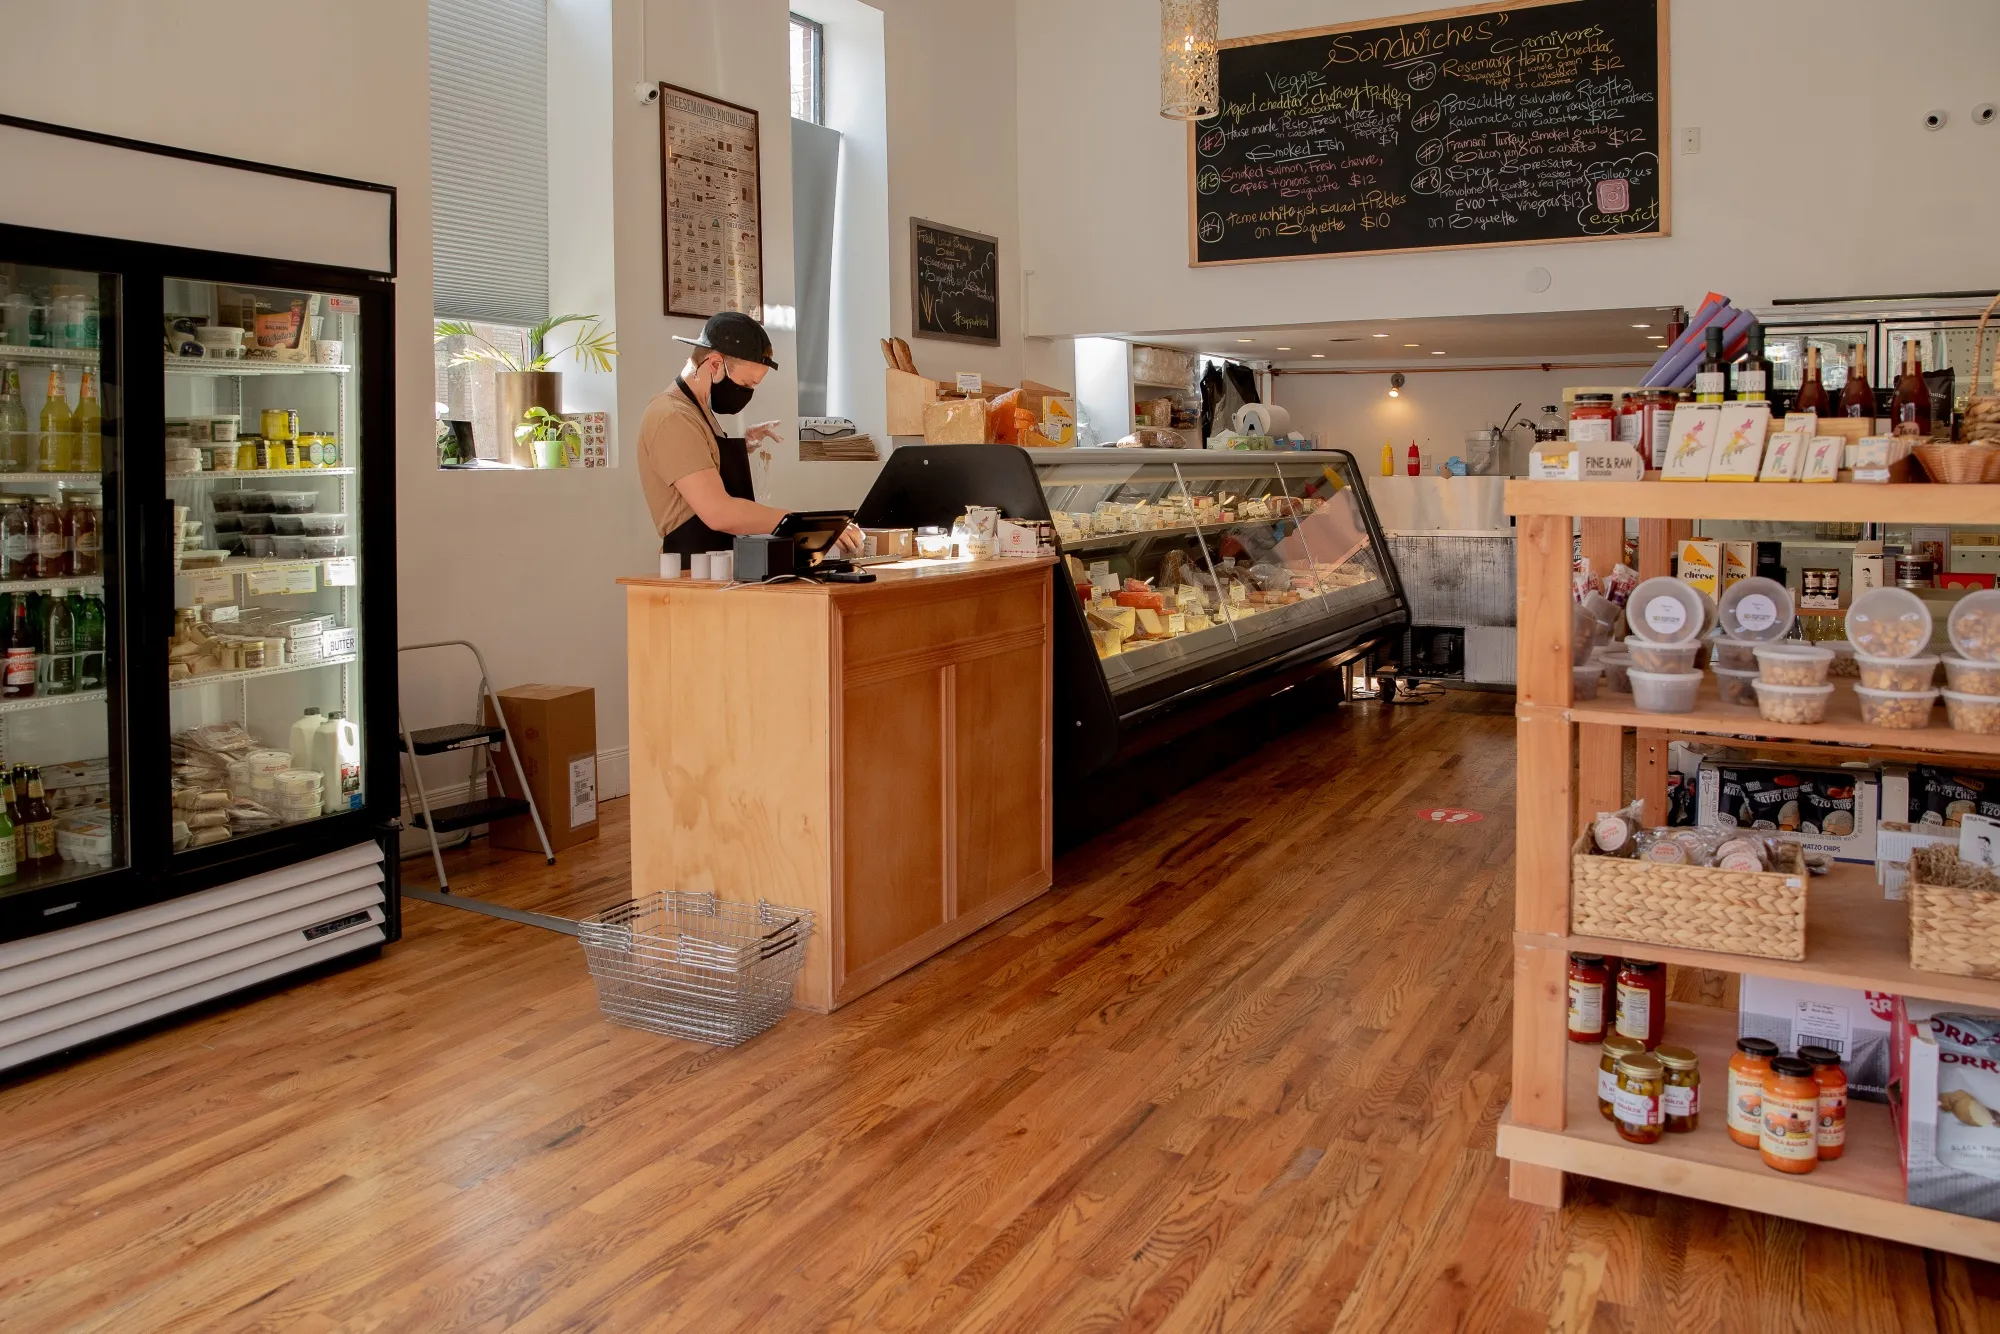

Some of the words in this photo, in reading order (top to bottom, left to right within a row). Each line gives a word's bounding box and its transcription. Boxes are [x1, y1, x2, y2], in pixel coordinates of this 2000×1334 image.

[1491, 23, 1605, 54] Carnivores
[1438, 55, 1516, 78] Rosemary
[1516, 47, 1551, 67] Ham
[1590, 55, 1625, 75] $12
[1265, 71, 1326, 98] Veggie
[665, 93, 717, 119] CHEESEMAKING
[717, 109, 755, 130] KNOWLEDGE
[1224, 92, 1257, 124] Aged
[1415, 106, 1440, 126] #6
[1448, 112, 1513, 130] Kalamata
[1515, 107, 1544, 120] olives
[1548, 105, 1562, 116] or
[1584, 108, 1625, 126] $12
[1200, 131, 1224, 152] #2
[1251, 117, 1279, 134] made
[1309, 113, 1342, 128] Fresh
[1345, 108, 1379, 121] Mozz
[1606, 126, 1647, 149] $12
[1245, 139, 1311, 161] Smoked
[1314, 139, 1346, 152] Fish
[1530, 144, 1544, 155] on
[1199, 170, 1221, 190] #3
[1220, 164, 1264, 183] Smoked
[1305, 159, 1338, 173] Fresh
[1316, 174, 1330, 184] on
[1348, 174, 1378, 188] $12
[1414, 168, 1440, 190] #8
[1446, 164, 1494, 188] Spicy
[1587, 168, 1632, 182] Follow
[1635, 168, 1652, 177] us
[1280, 181, 1341, 201] Baguette
[1439, 182, 1485, 198] Provolone
[1538, 178, 1554, 188] red
[1455, 198, 1486, 212] EVOO
[1561, 191, 1585, 212] $13
[1200, 217, 1222, 238] #4
[1226, 211, 1258, 227] Acme
[1319, 198, 1357, 214] salad
[1360, 211, 1391, 231] $10
[1428, 216, 1444, 229] on
[1448, 210, 1519, 231] Baguette
[1254, 227, 1271, 239] on
[1275, 219, 1347, 244] Baguette
[1585, 456, 1606, 469] FINE
[1606, 456, 1613, 469] &
[1613, 456, 1634, 469] RAW
[1585, 469, 1613, 477] chocolate
[1683, 571, 1716, 581] cheese
[330, 637, 356, 652] BUTTER
